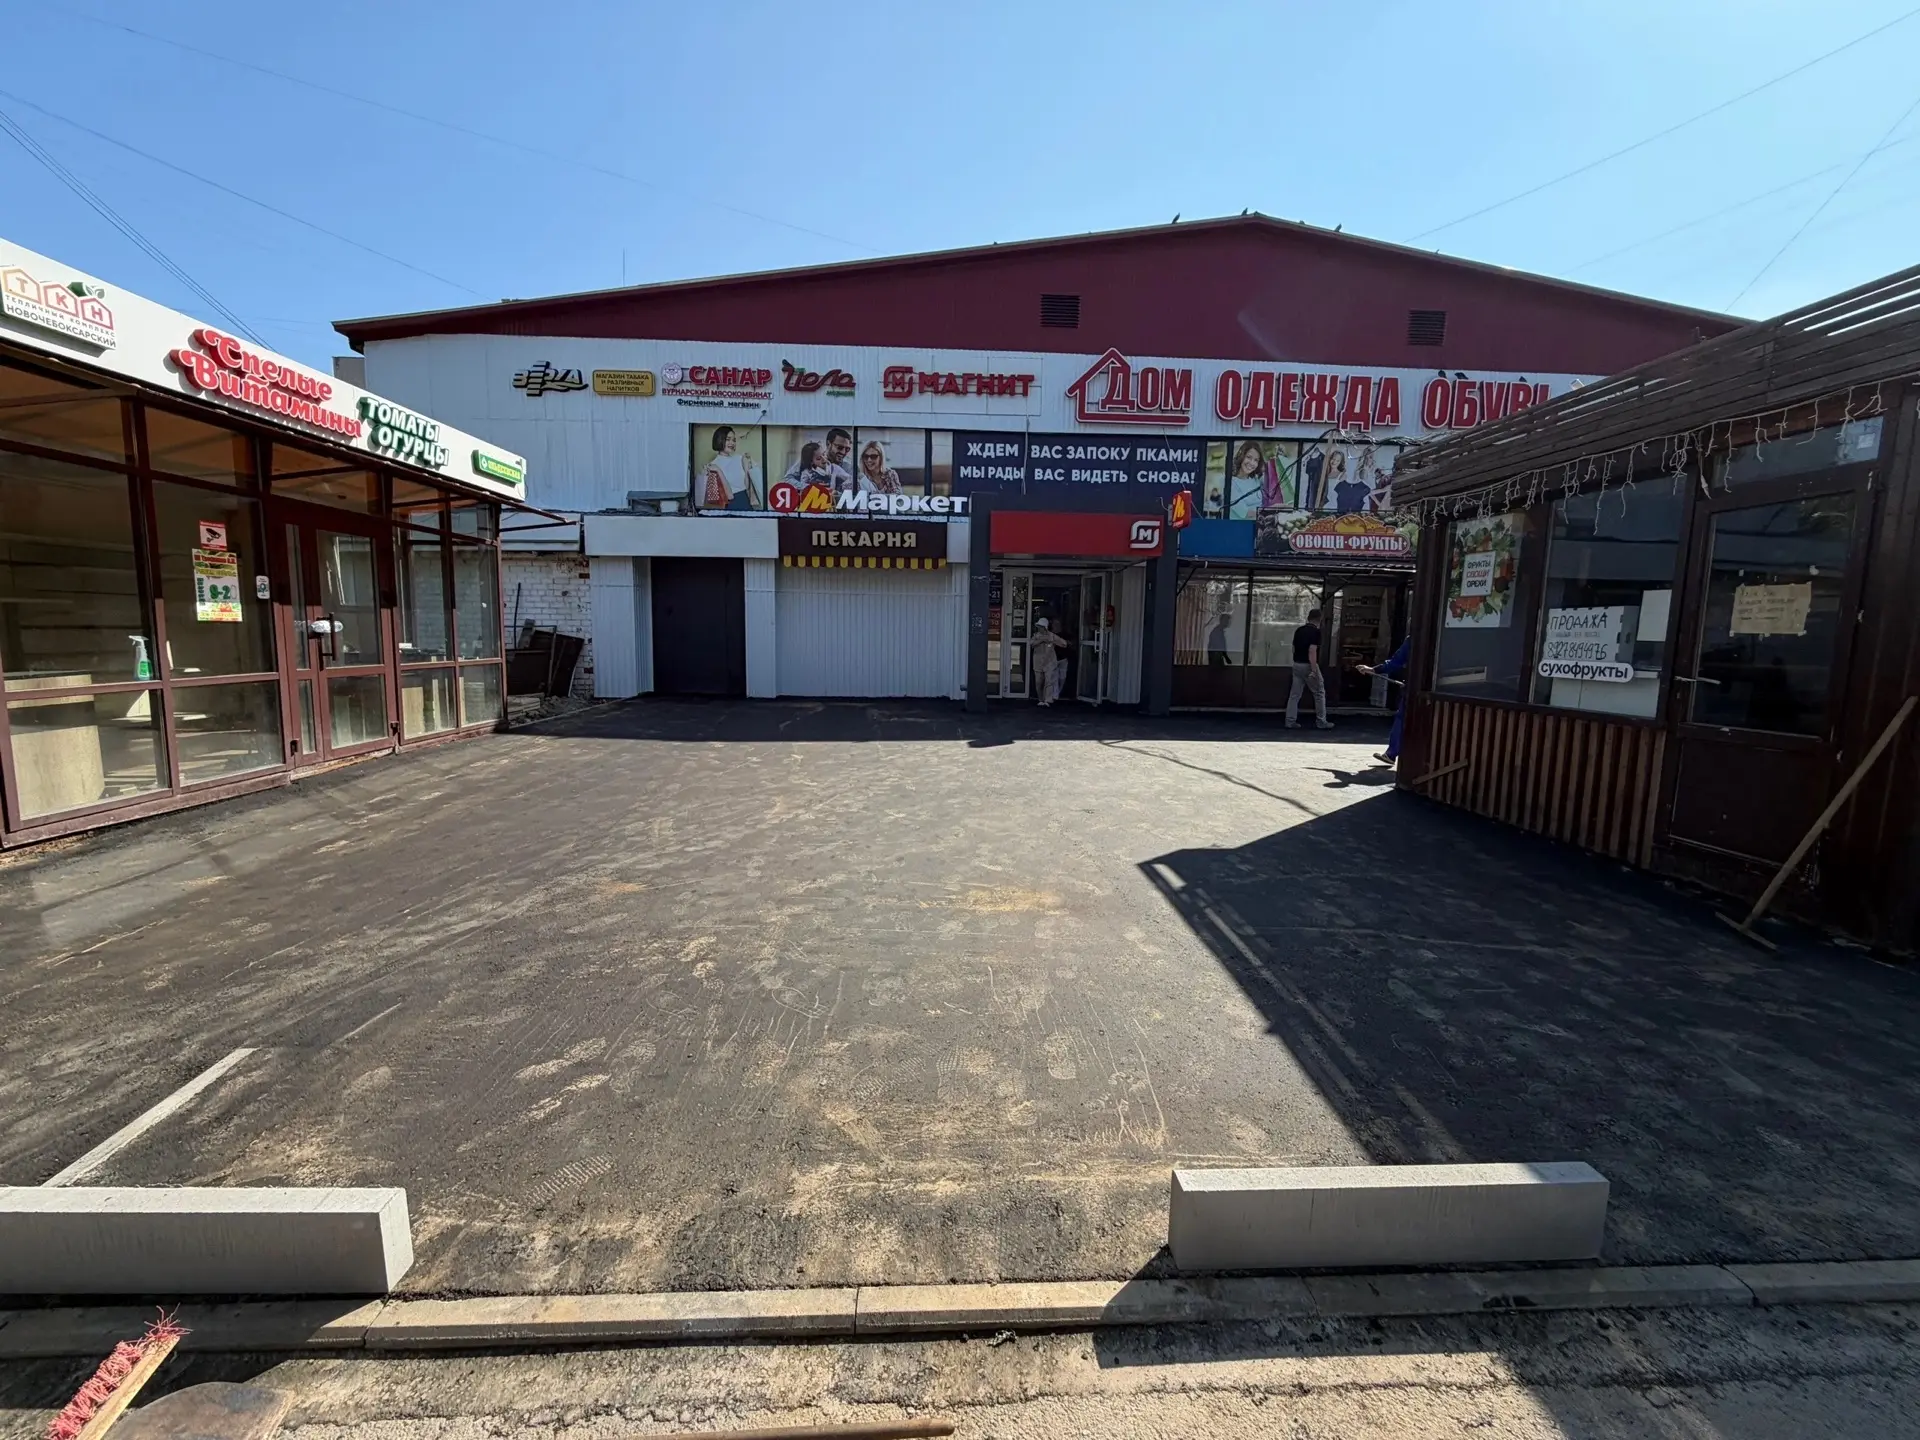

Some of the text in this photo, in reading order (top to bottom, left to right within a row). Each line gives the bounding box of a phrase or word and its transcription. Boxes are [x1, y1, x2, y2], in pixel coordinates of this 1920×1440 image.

[5, 294, 116, 338] ТЕПЛИЧНЫЙ КОМПЛЕКС
[6, 304, 117, 348] НОВОЧЕБОКСАРСКИЙ
[202, 328, 333, 401] Спелые
[626, 373, 650, 381] ТАБАКА
[689, 365, 773, 387] САНАР
[918, 372, 1035, 397] МАГНИТ
[179, 350, 362, 438] Витамины
[662, 387, 773, 400] ВУРНАРСКИЙ МЯСОКОМБИНАТ
[676, 398, 761, 409] Фирменный магазин
[1098, 364, 1193, 412] ДОМ
[1216, 369, 1401, 432] ОДЕЖДА
[366, 398, 441, 444] ТОМАТЫ
[377, 425, 450, 467] ОГУРЦЫ
[966, 442, 1019, 459] ЖДЕМ
[1030, 445, 1063, 460] ВАС
[959, 466, 1196, 485] МЫ РАДЫ ВАС ВИДЕТЬ СНОВА!
[835, 489, 968, 515] Маркет
[811, 530, 917, 548] ПЕКАРНЯ
[1467, 560, 1491, 569] ФРУКТЫ
[1466, 580, 1487, 588] ОРЕХИ
[1549, 612, 1608, 630] ПРОДАЖА
[1540, 662, 1629, 679] сухофрукты
